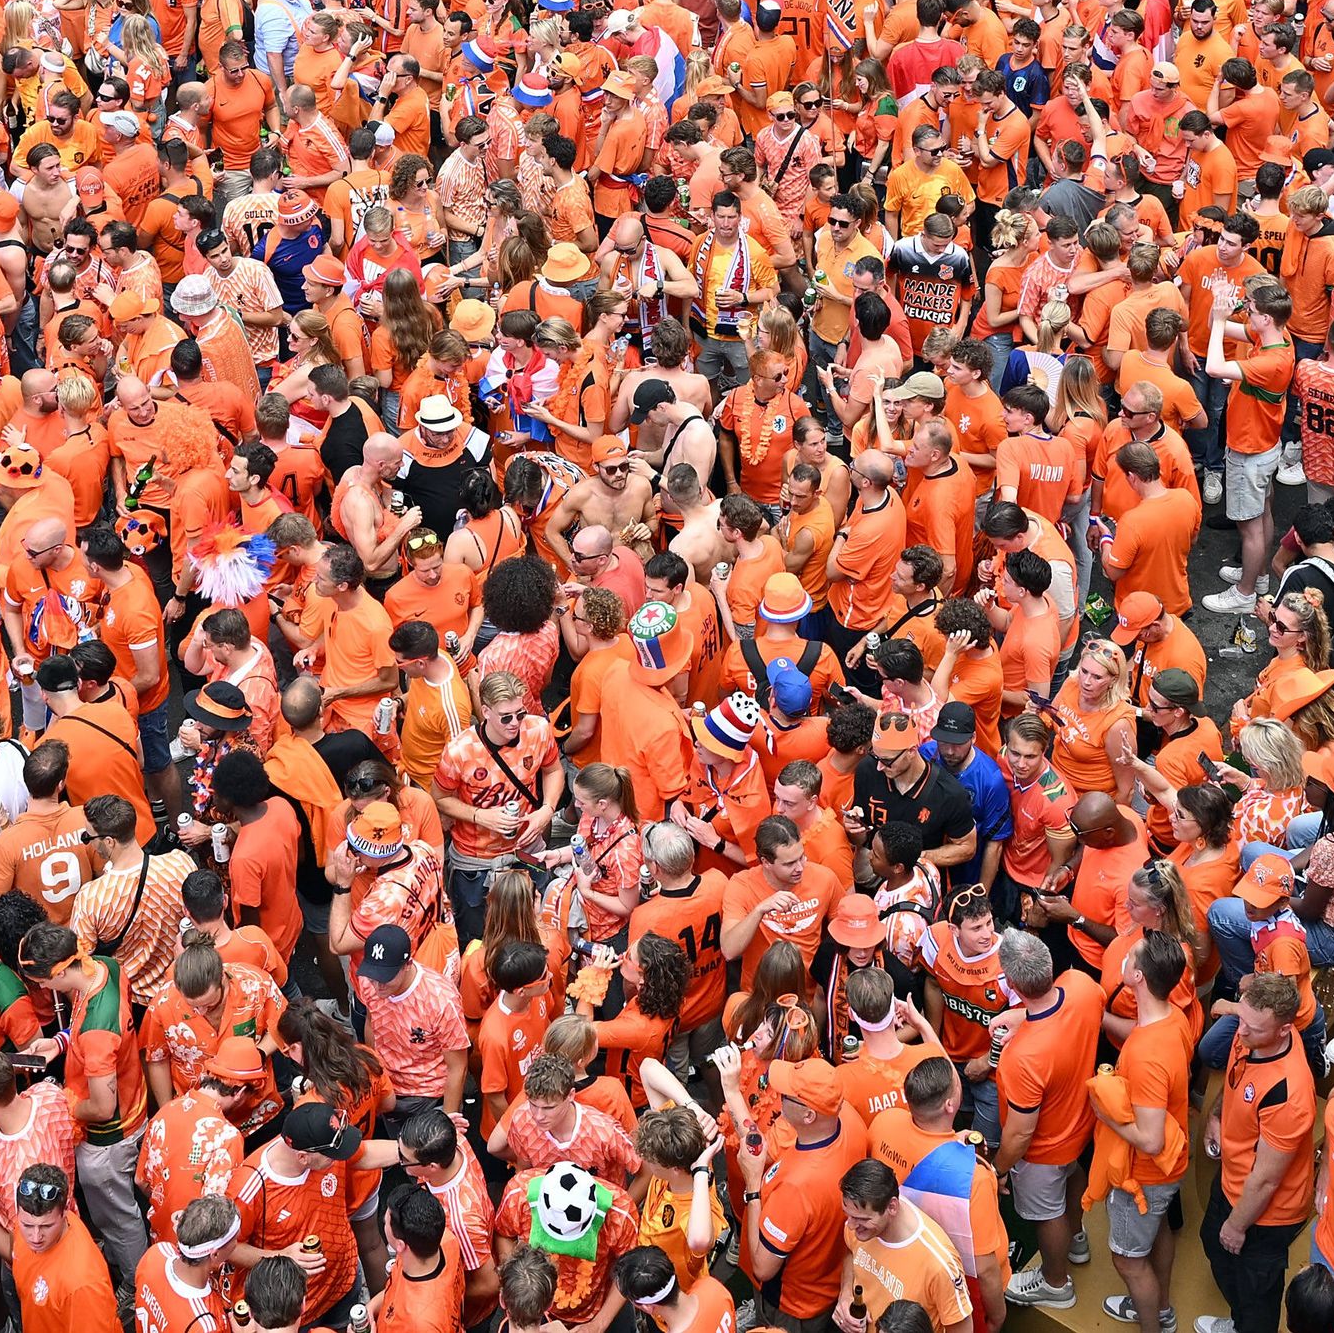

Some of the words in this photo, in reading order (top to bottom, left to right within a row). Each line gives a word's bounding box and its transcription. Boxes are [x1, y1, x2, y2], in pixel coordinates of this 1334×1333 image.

[780, 17, 811, 50] 21
[244, 210, 275, 219] GULLIT
[904, 278, 956, 298] MANDE
[904, 292, 955, 311] MAKERS
[904, 305, 953, 324] KEUKENS
[21, 829, 84, 861] HOLLAND
[352, 835, 397, 856] HOLLAND
[41, 852, 83, 903] 9
[678, 913, 722, 965] 14
[868, 1091, 898, 1113] JAAP
